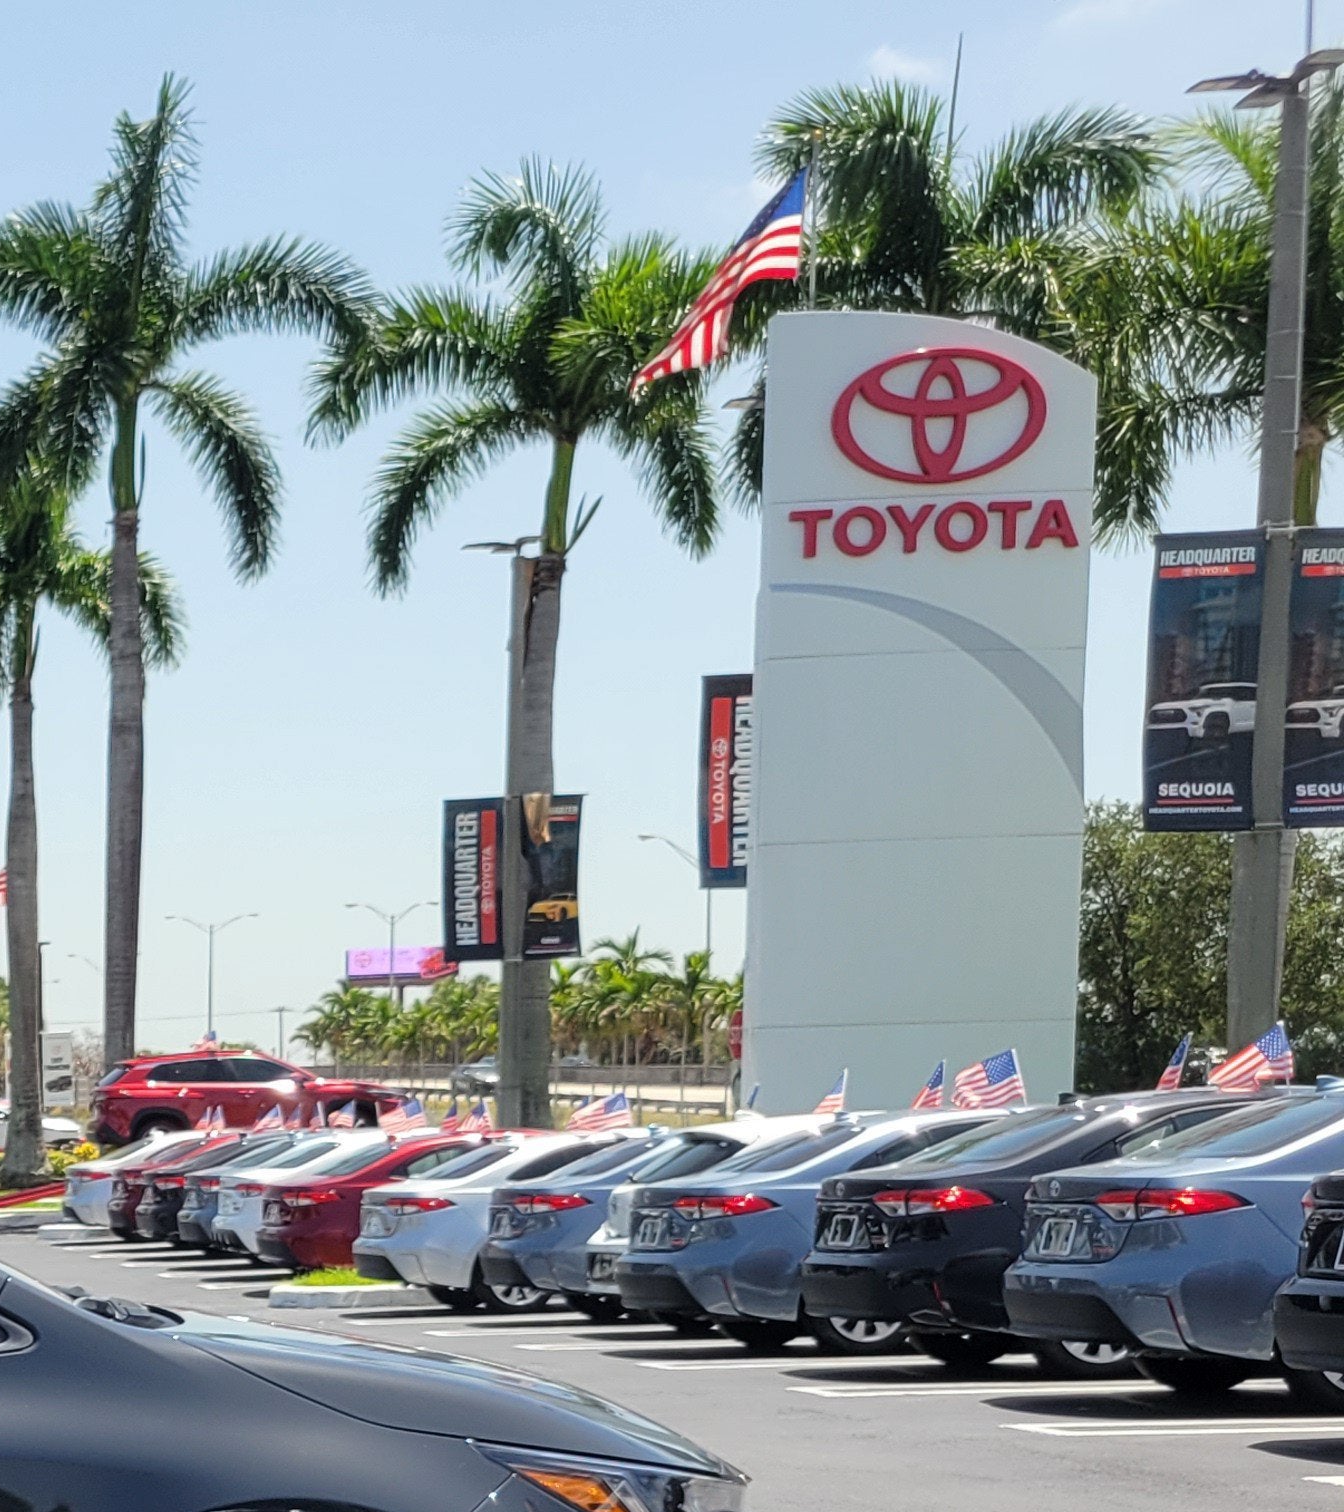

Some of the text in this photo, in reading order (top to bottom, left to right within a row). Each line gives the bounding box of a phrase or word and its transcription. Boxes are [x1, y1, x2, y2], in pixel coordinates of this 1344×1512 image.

[788, 500, 1079, 559] TOYOTA
[1160, 547, 1256, 567] HEADQUARTER
[1302, 548, 1344, 565] HEADQ
[1193, 565, 1230, 575] TOYOTA
[712, 763, 726, 824] TOYOTA
[1158, 782, 1234, 797] SEQUOIA
[1296, 783, 1344, 797] SEQU
[454, 811, 480, 946] HEADQUARTER
[481, 847, 492, 897] TOYOTA
